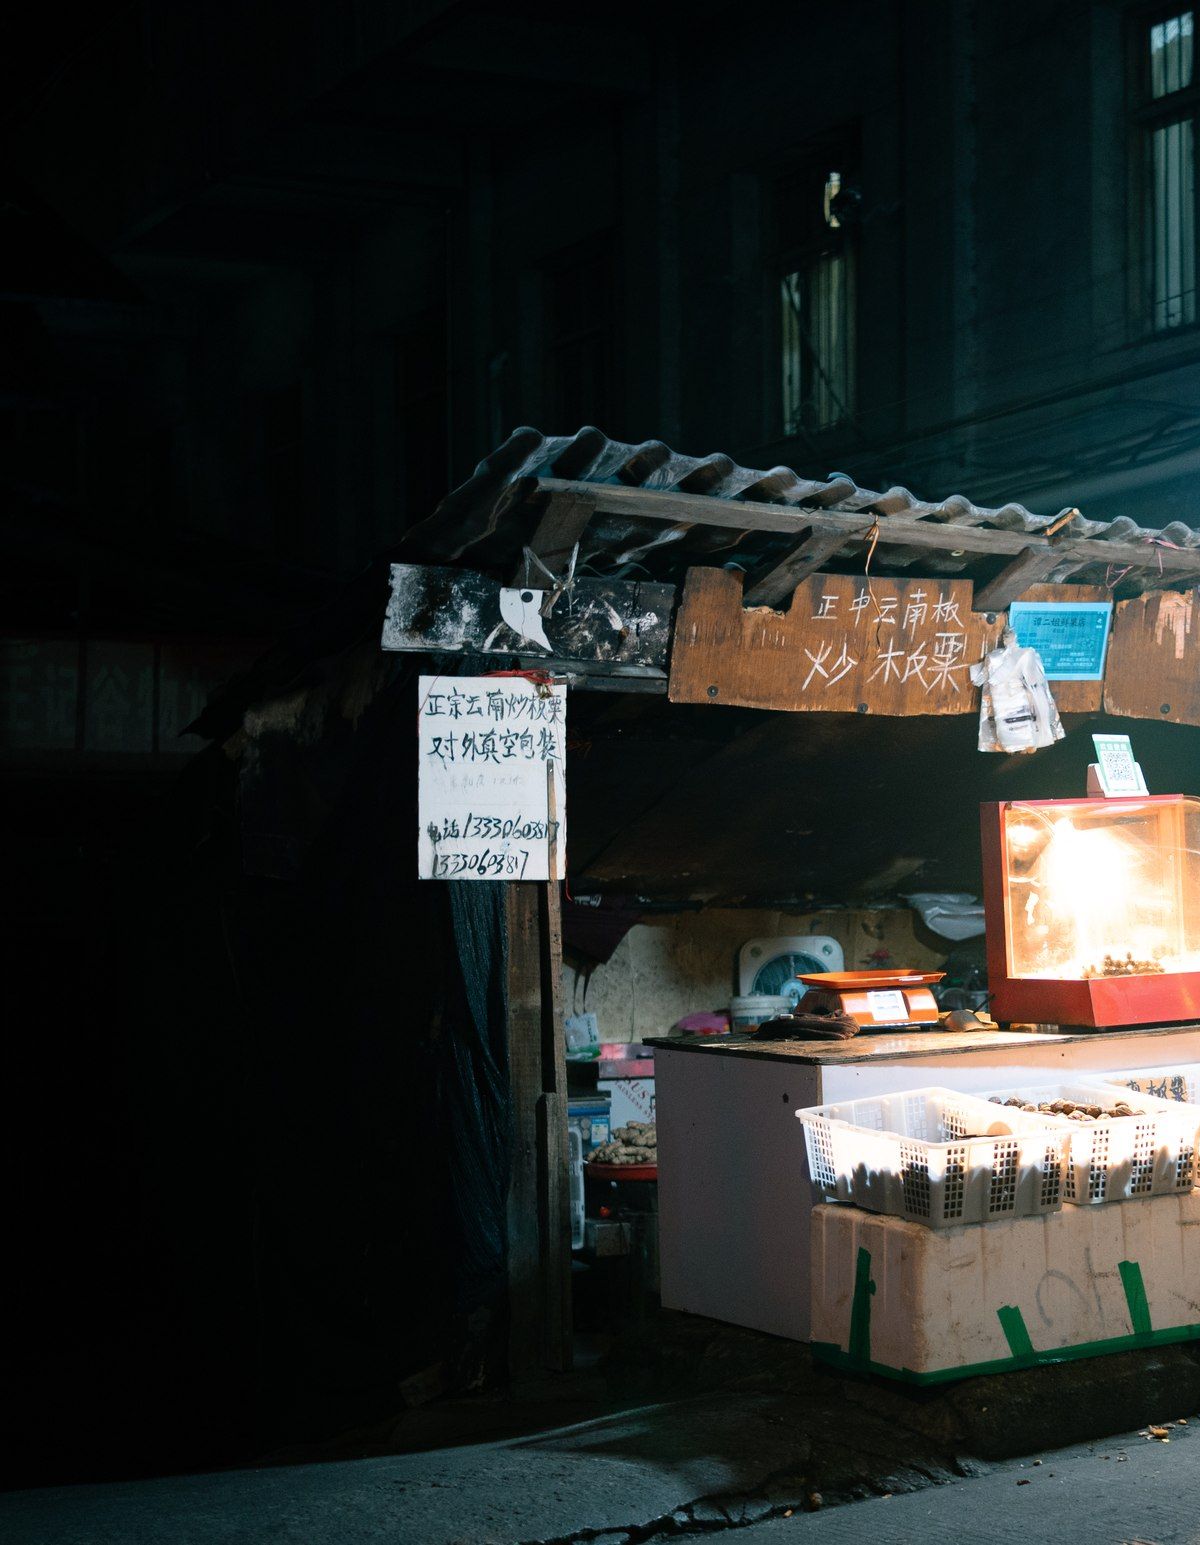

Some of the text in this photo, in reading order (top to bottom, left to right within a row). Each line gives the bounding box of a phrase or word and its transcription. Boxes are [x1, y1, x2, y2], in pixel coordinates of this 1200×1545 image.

[427, 727, 562, 764] 对外真空包装
[432, 848, 529, 881] 13330603817
